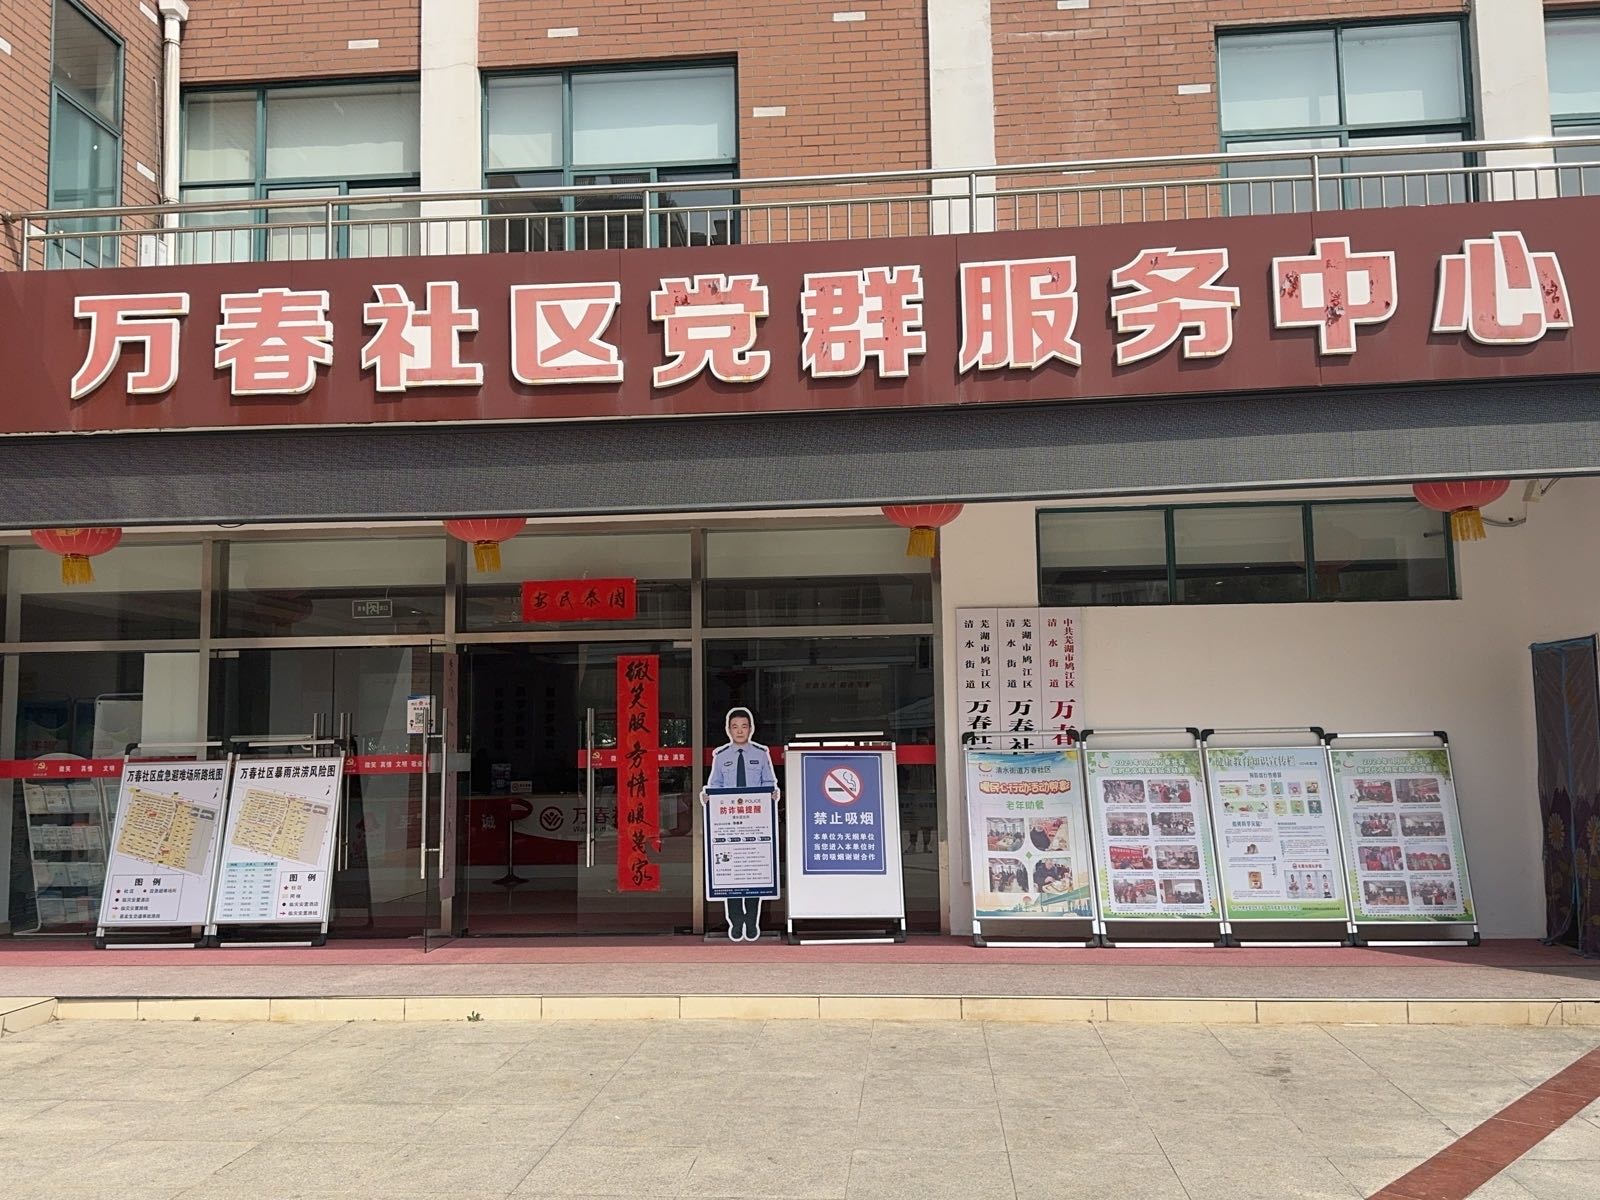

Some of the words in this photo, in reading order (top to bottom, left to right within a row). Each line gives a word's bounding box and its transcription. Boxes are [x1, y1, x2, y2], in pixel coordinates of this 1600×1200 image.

[71, 231, 1574, 399] 万春社区党群服务中心
[964, 620, 976, 689] 清水街道
[980, 619, 991, 689] 芜湖市鸠江区
[1005, 618, 1017, 689] 清水街道
[1021, 618, 1033, 689] 芜湖市鸠江区
[1047, 618, 1059, 688] 清水街道
[1063, 618, 1076, 689] 中共芜湖市鸠江区
[1007, 699, 1035, 755] 万春社
[126, 768, 224, 782] 万春社区应急避难场所路线图
[239, 764, 336, 780] 万春社区暴雨洪涝风险图
[995, 765, 1051, 775] 清水街道万春社区
[720, 805, 762, 815] 防诈骗提醒
[1006, 800, 1046, 811] 老年助餐
[813, 811, 875, 826] 禁止吸烟
[813, 832, 875, 841] 本单位为无烟单位
[813, 843, 875, 851] 当您进入本单位时
[813, 853, 876, 861] 请勿吸烟谢谢合作
